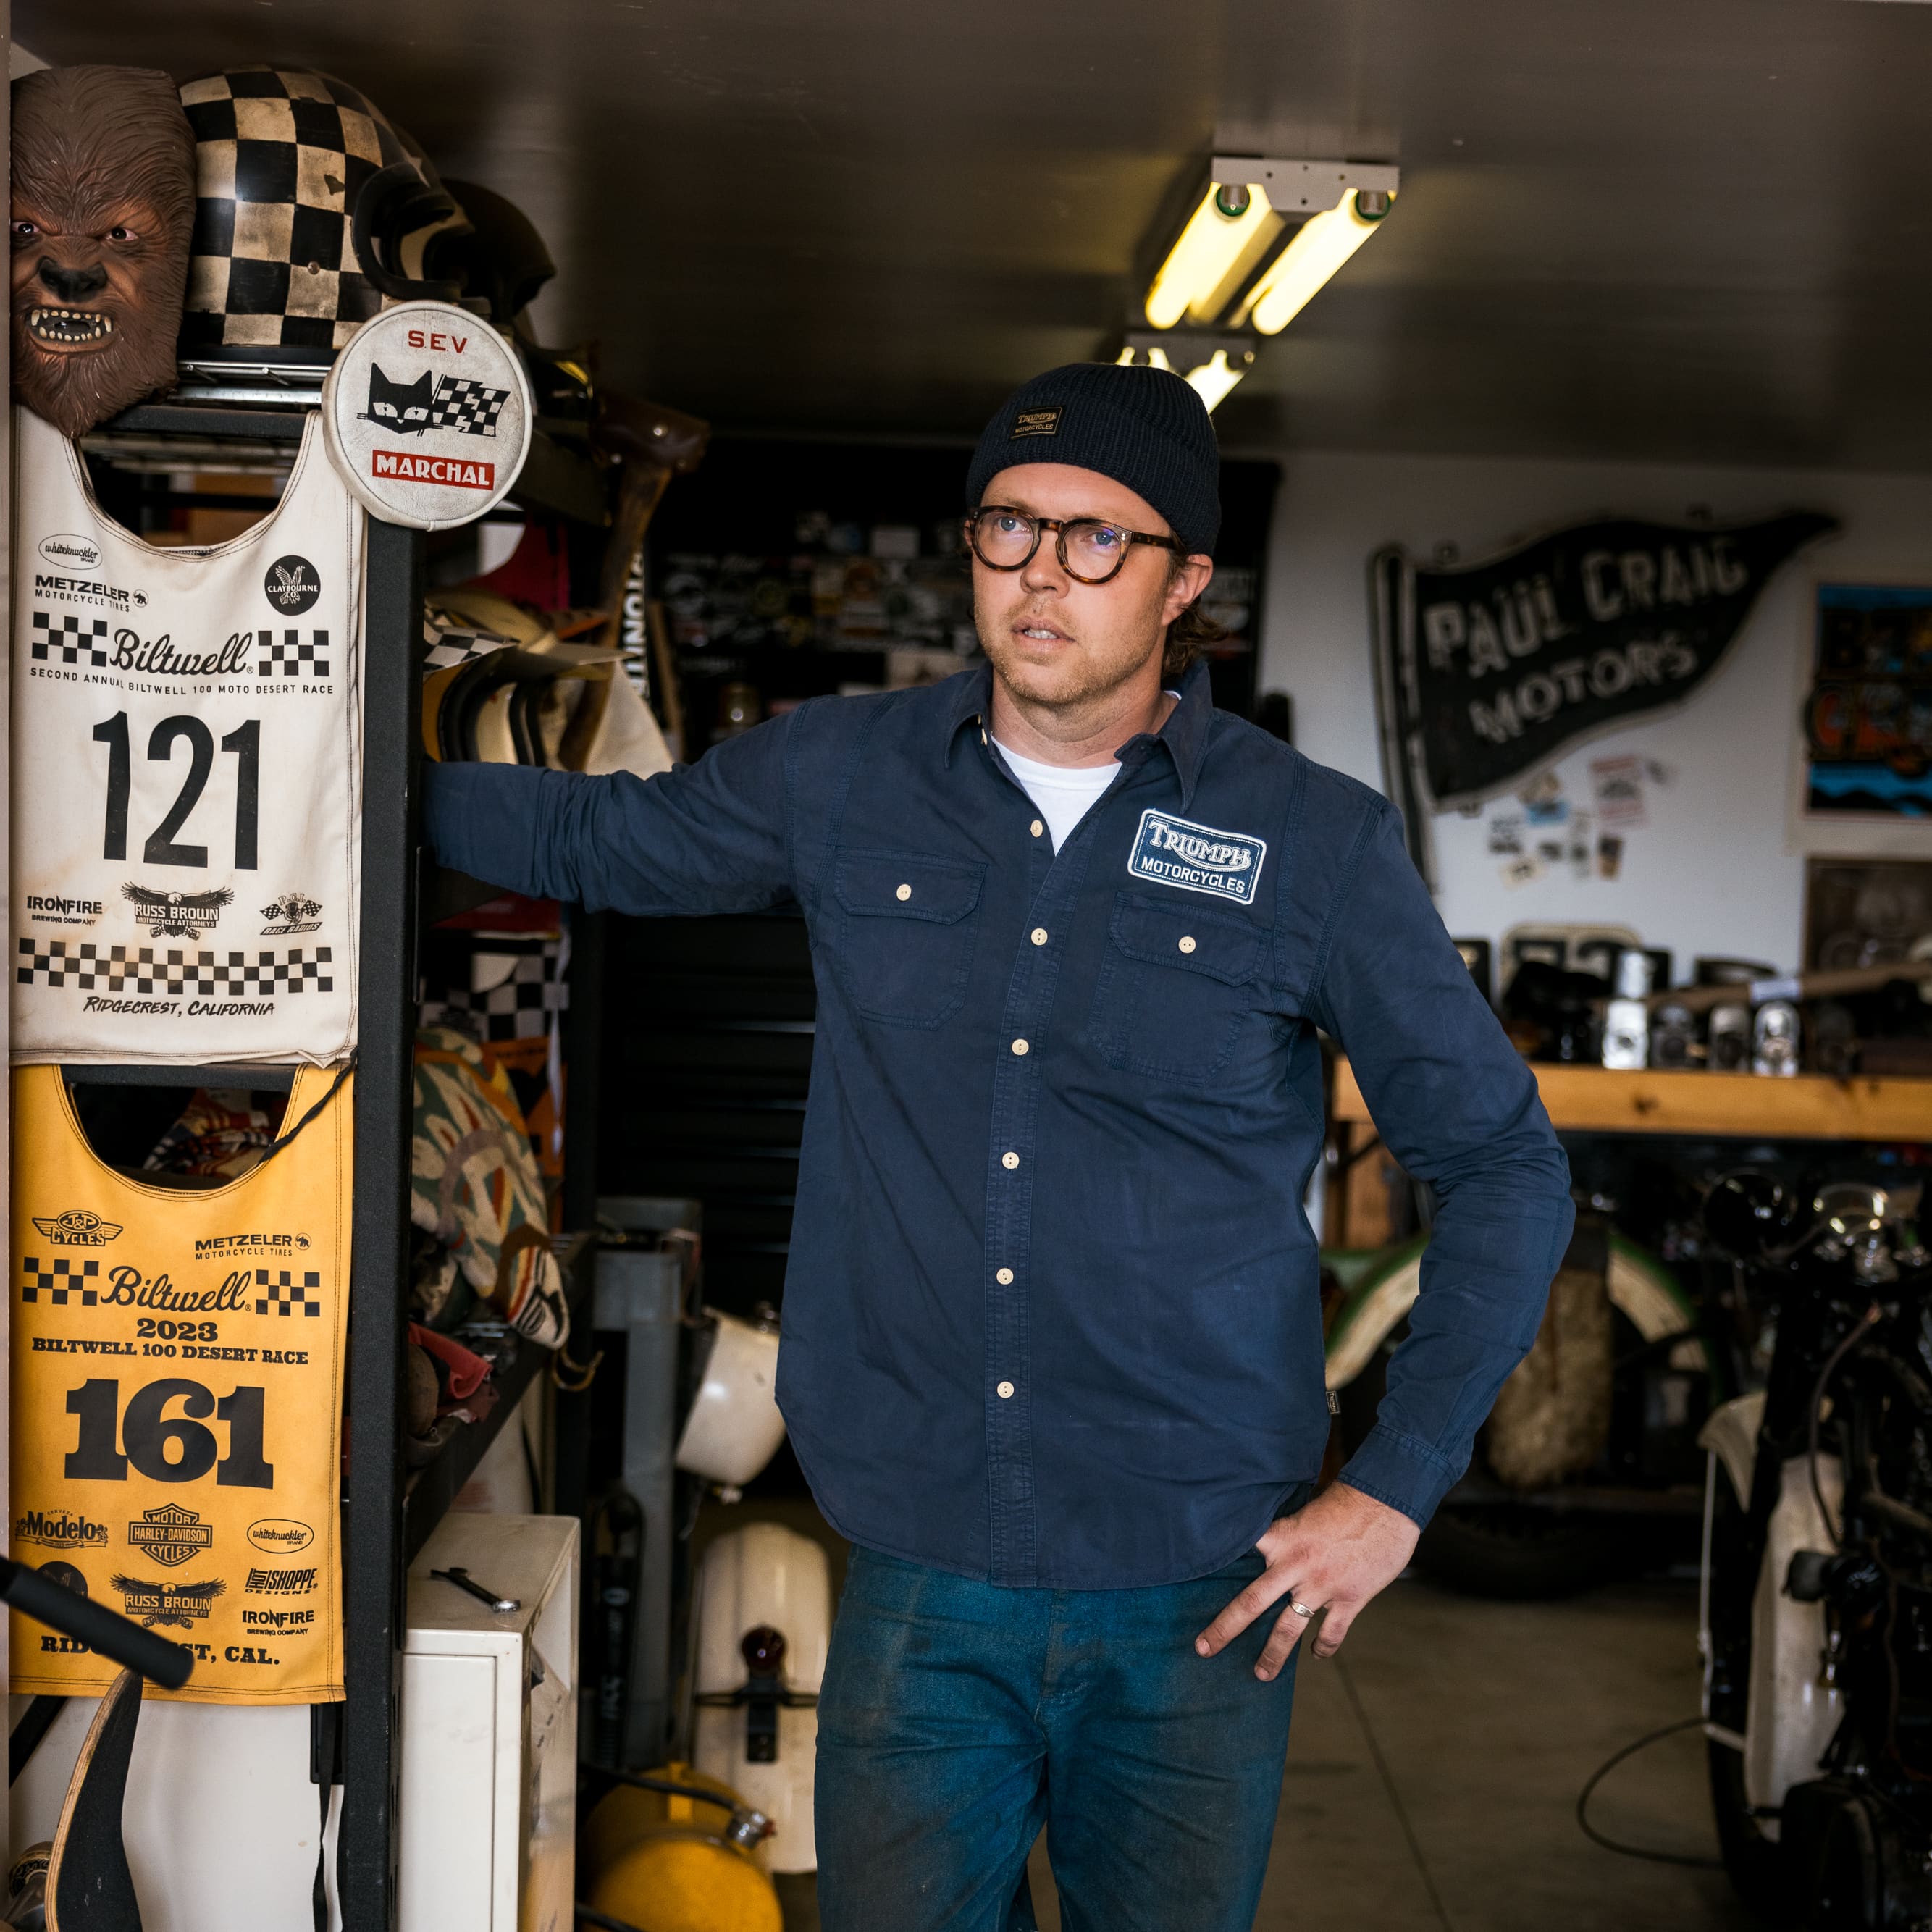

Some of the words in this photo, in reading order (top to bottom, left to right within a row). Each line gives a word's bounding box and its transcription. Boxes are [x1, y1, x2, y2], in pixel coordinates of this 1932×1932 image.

[1015, 424, 1054, 433] MOTORCYCLES
[1017, 412, 1057, 424] TRIUMPH
[376, 454, 490, 486] MARCHAL
[45, 542, 98, 559] whiteknuckler
[35, 574, 130, 602] METZELER
[35, 589, 104, 606] MOTORCYCLE
[109, 600, 130, 613] TIRES
[110, 628, 253, 676] Biltwell
[30, 667, 77, 681] SECOND
[83, 673, 124, 689] ANNUAL
[128, 682, 187, 695] BILTWELL
[193, 685, 212, 694] 100
[219, 685, 250, 694] MOTO
[256, 684, 295, 694] DESERT
[303, 685, 333, 694] RACE
[1468, 632, 1697, 744] MOTORS
[92, 710, 261, 870] 121
[1148, 819, 1252, 872] TRIUMPH
[1141, 856, 1246, 894] MOTORCYCLES
[27, 894, 103, 916] IRONFIRE
[135, 904, 166, 917] RUSS
[169, 906, 218, 920] BROWN
[31, 914, 62, 923] BREWING
[63, 917, 96, 926] COMPANY
[137, 917, 176, 926] MOTORCYCLE
[177, 919, 215, 928] ATTORNEYS
[188, 1000, 275, 1016] CALIFORNIA
[51, 1226, 105, 1246] CYCLES
[195, 1234, 293, 1251] METZELER
[196, 1248, 264, 1260] MOTORCYCLE
[270, 1248, 293, 1257] TIRES
[101, 1265, 251, 1312] Biltwell
[137, 1317, 218, 1342] 2023
[32, 1337, 137, 1356] BILTWELL
[142, 1343, 177, 1358] 100
[182, 1345, 257, 1363] DESERT
[261, 1349, 308, 1365] RACE
[64, 1377, 274, 1490] 161
[27, 1511, 96, 1540] Modelo
[152, 1509, 190, 1524] MOTOR
[134, 1526, 207, 1542] HARLEY-DAVIDSON
[253, 1527, 306, 1541] whiteknuckler
[151, 1545, 190, 1562] CYCLES
[268, 1568, 317, 1590] SHOPPE
[125, 1595, 159, 1608] RUSS
[164, 1596, 211, 1610] BROWN
[242, 1609, 314, 1628] IRONFIRE
[277, 1627, 309, 1636] COMPANY
[224, 1644, 280, 1666] CAL.
